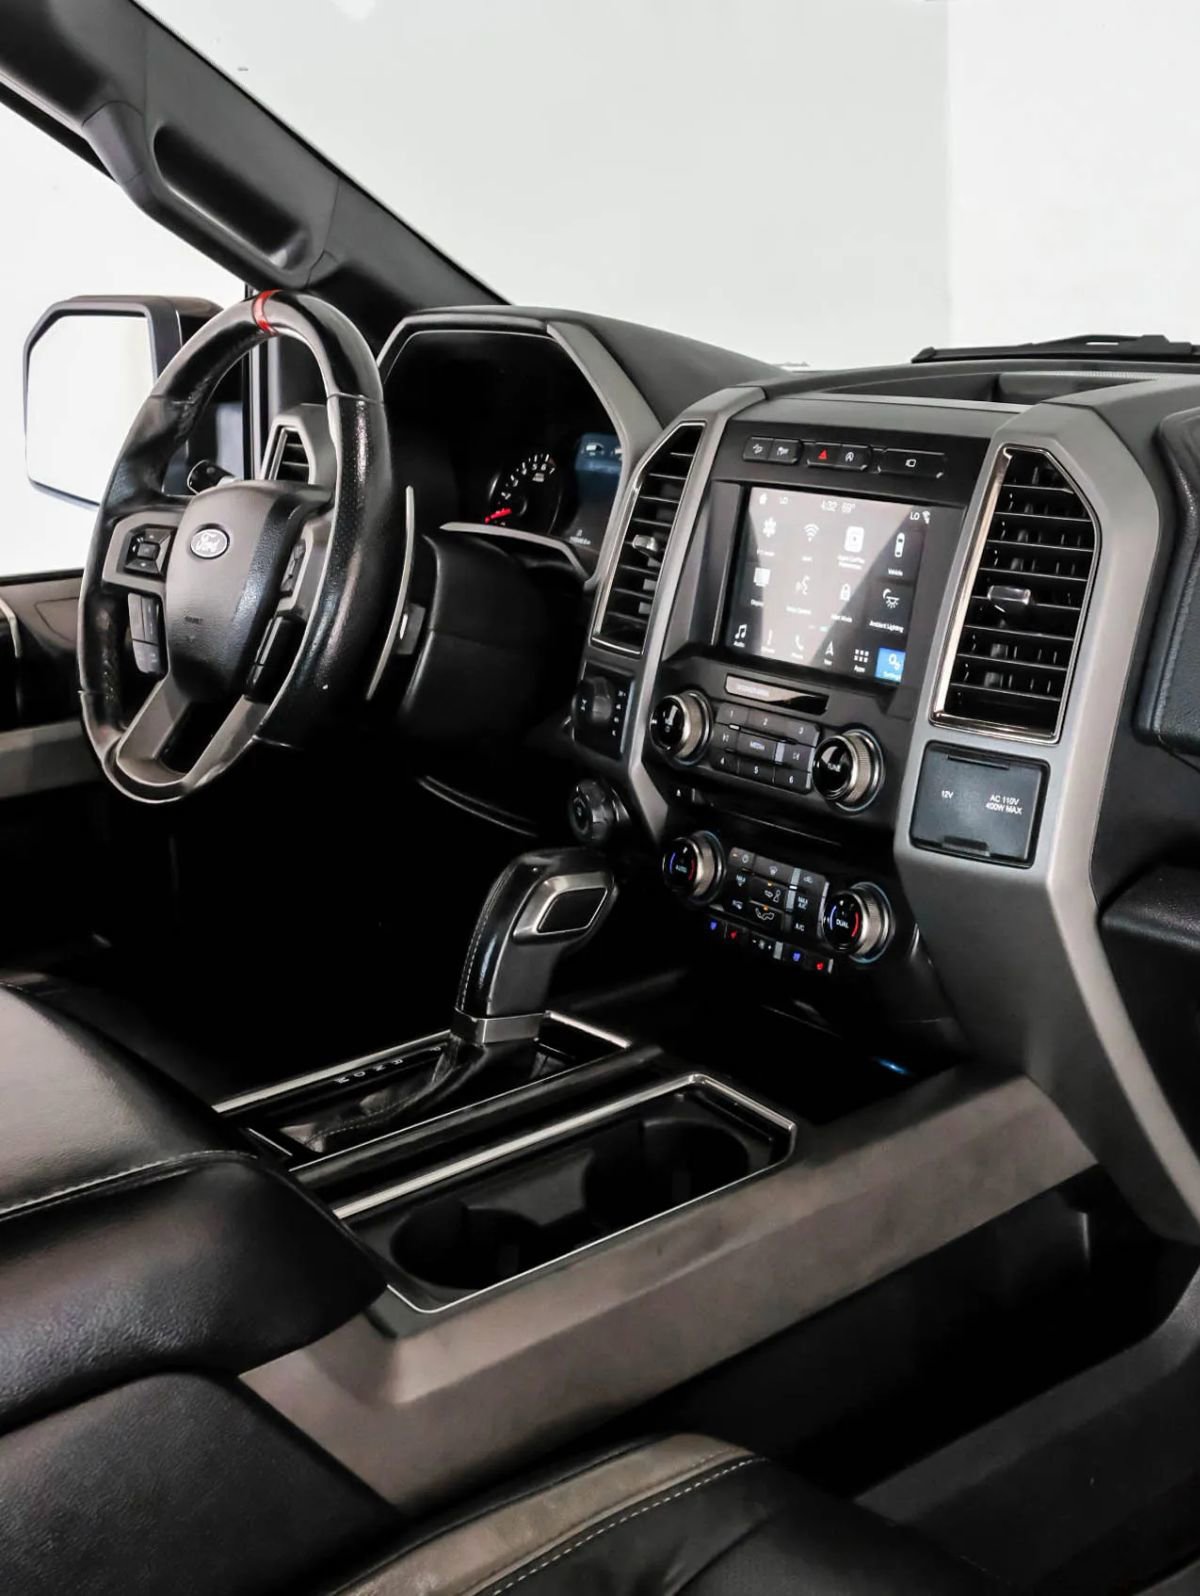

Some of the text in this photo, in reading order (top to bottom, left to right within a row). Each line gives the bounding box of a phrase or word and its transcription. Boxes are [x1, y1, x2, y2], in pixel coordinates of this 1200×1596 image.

[909, 511, 920, 521] LO
[194, 530, 222, 554] Ford
[941, 790, 953, 799] 12V
[990, 794, 1019, 805] AC 110V
[985, 802, 1022, 815] 400W MAX
[835, 918, 849, 929] DUAL
